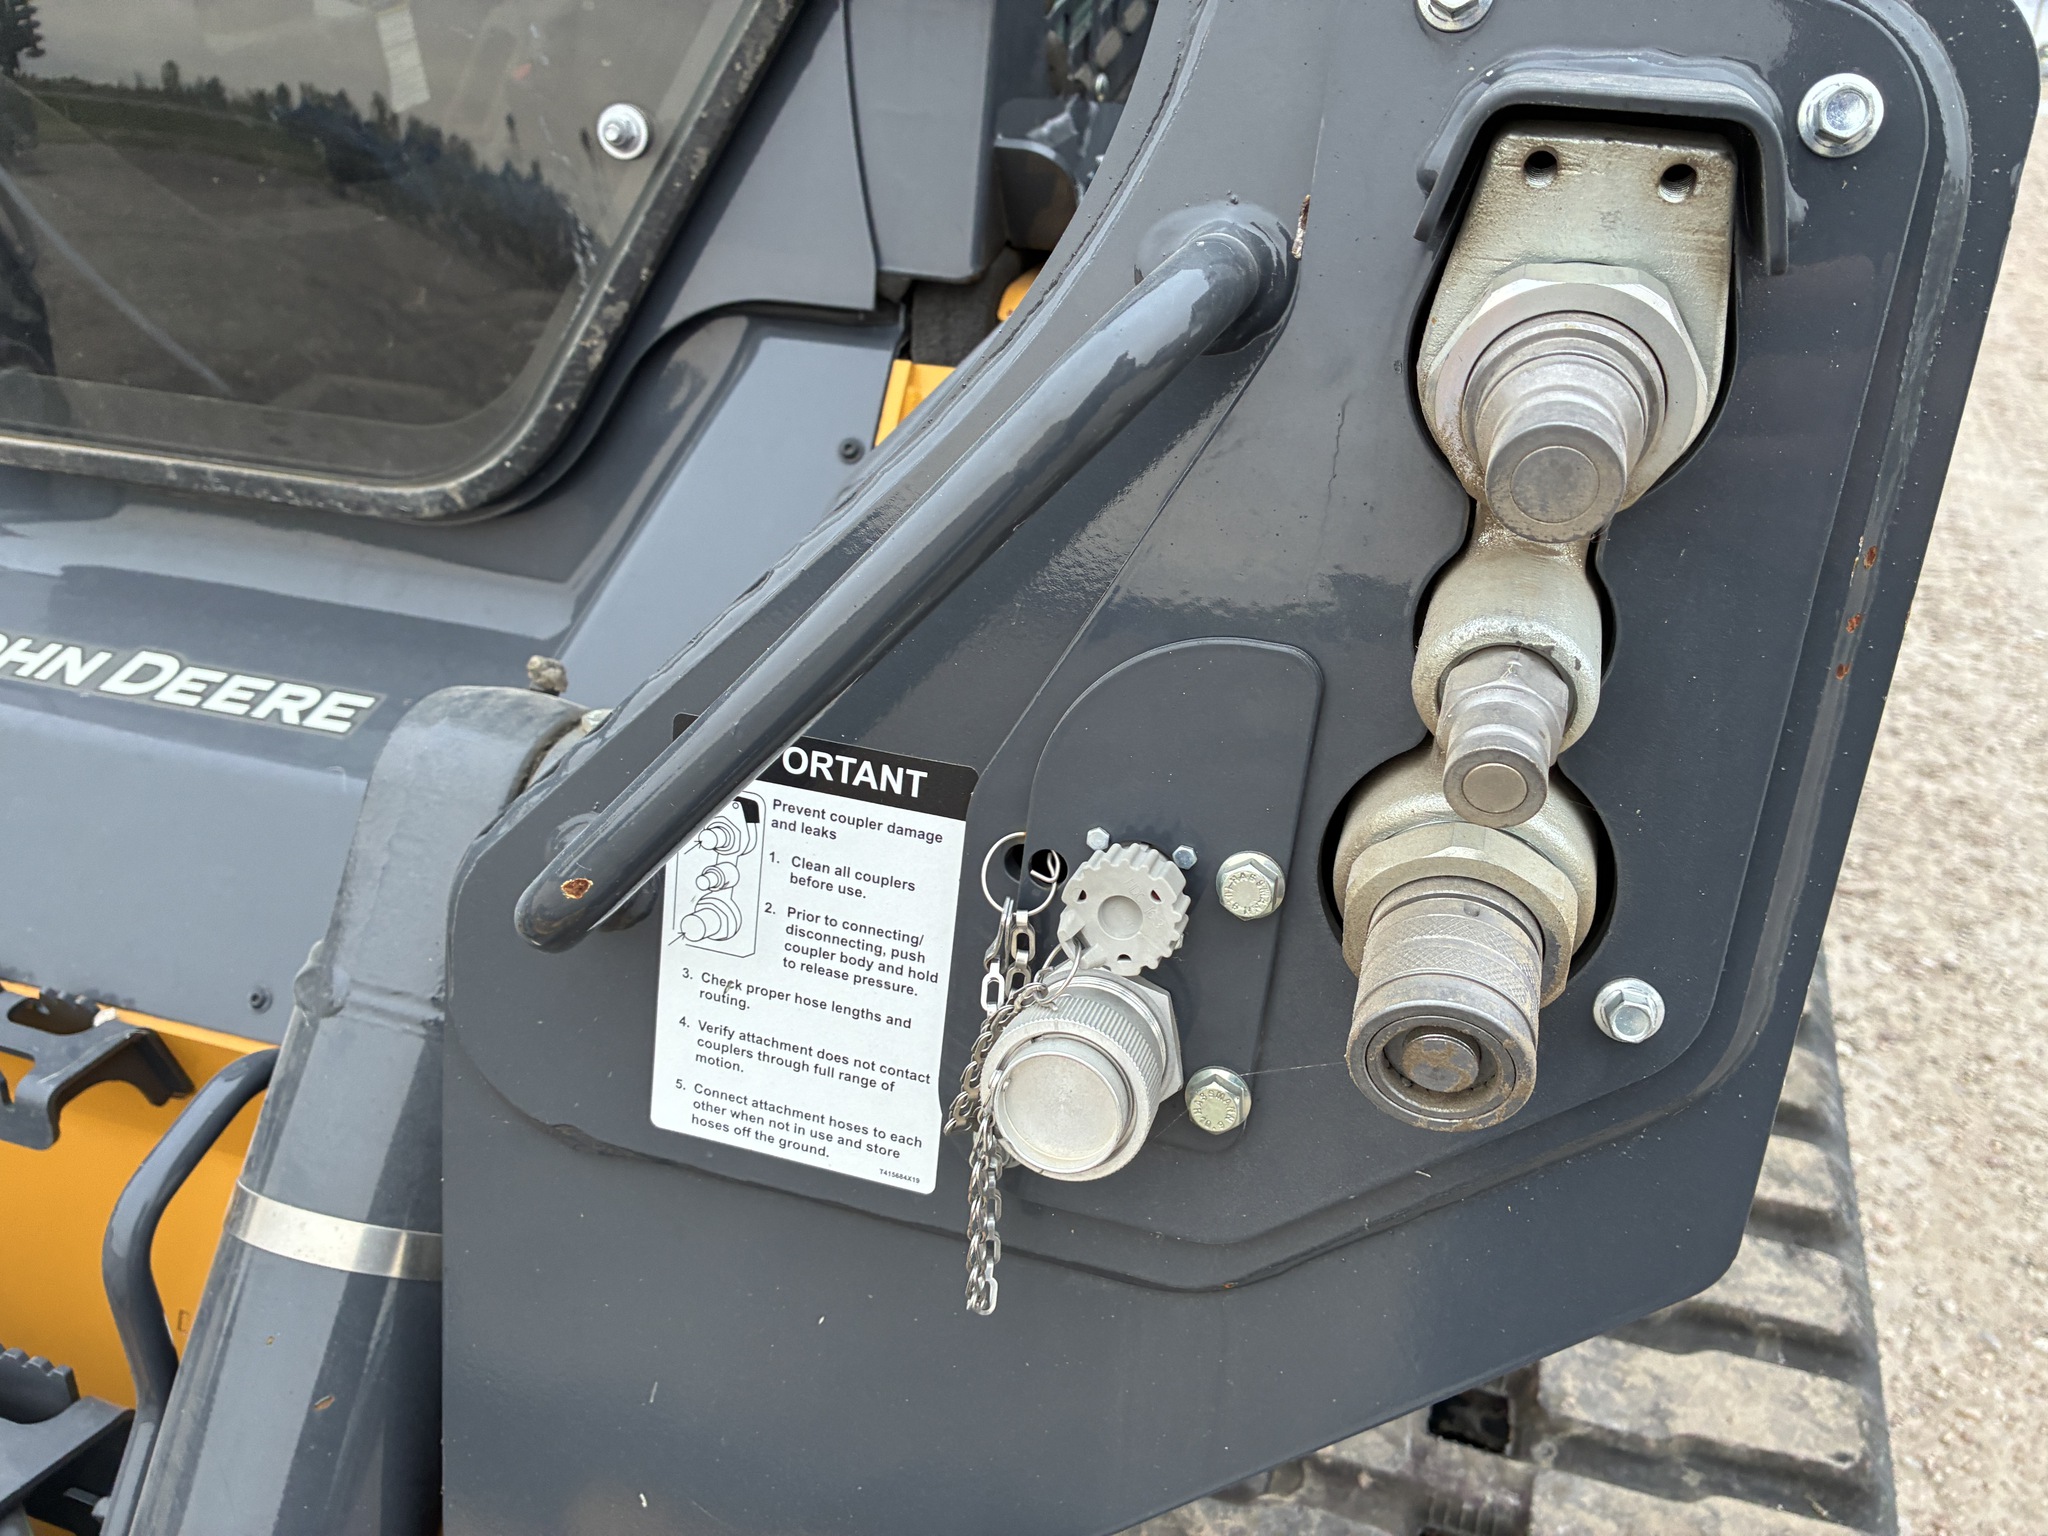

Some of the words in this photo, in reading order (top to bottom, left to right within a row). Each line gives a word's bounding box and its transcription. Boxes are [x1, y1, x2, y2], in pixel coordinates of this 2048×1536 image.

[0, 633, 112, 686] HN
[98, 651, 375, 733] DEERE
[782, 746, 928, 798] ORTANT
[771, 819, 796, 832] and
[801, 822, 836, 840] leaks
[773, 799, 826, 820] Prevent
[830, 813, 883, 831] coupler
[887, 822, 943, 844] damage
[769, 851, 779, 863] 1.
[792, 856, 830, 874] Clean
[834, 866, 850, 878] all
[855, 872, 915, 891] couplers
[790, 872, 833, 891] before
[838, 885, 866, 898] use.
[764, 902, 775, 914] 2.
[787, 906, 821, 923] Prior
[825, 915, 837, 927] to
[842, 921, 924, 947] connecting/
[786, 924, 886, 957] disconnecting,
[891, 949, 925, 963] push
[783, 957, 796, 969] to
[800, 963, 849, 980] release
[853, 975, 917, 996] pressure.
[784, 943, 836, 960] coupler
[840, 952, 874, 971] body
[878, 963, 903, 976] and
[908, 967, 938, 983] hold
[683, 968, 693, 979] 3.
[701, 972, 742, 991] Check
[746, 985, 791, 1001] proper
[795, 993, 827, 1010] hose
[832, 1001, 881, 1022] lengths
[886, 1016, 911, 1029] and
[700, 990, 750, 1010] routing.
[679, 1016, 689, 1027] 4.
[698, 1020, 735, 1040] Verify
[739, 1032, 813, 1056] attachment
[817, 1049, 849, 1065] does
[854, 1059, 875, 1071] not
[880, 1065, 930, 1084] contact
[696, 1054, 743, 1072] motion.
[697, 1039, 753, 1058] couplers
[758, 1051, 809, 1072] through
[814, 1063, 834, 1078] full
[839, 1072, 876, 1088] range
[881, 1081, 895, 1092] of
[676, 1079, 685, 1090] 5.
[694, 1083, 747, 1105] Connect
[752, 1100, 825, 1124] attachment
[829, 1116, 868, 1135] hoses
[873, 1127, 886, 1139] to
[890, 1134, 922, 1148] each
[692, 1114, 729, 1132] hoses
[734, 1127, 751, 1137] off
[755, 1130, 774, 1143] the
[779, 1138, 829, 1157] ground.
[693, 1101, 726, 1115] other
[730, 1110, 764, 1125] when
[769, 1120, 789, 1131] not
[794, 1123, 805, 1135] in
[810, 1130, 833, 1142] use
[837, 1137, 862, 1149] and
[866, 1144, 900, 1158] store
